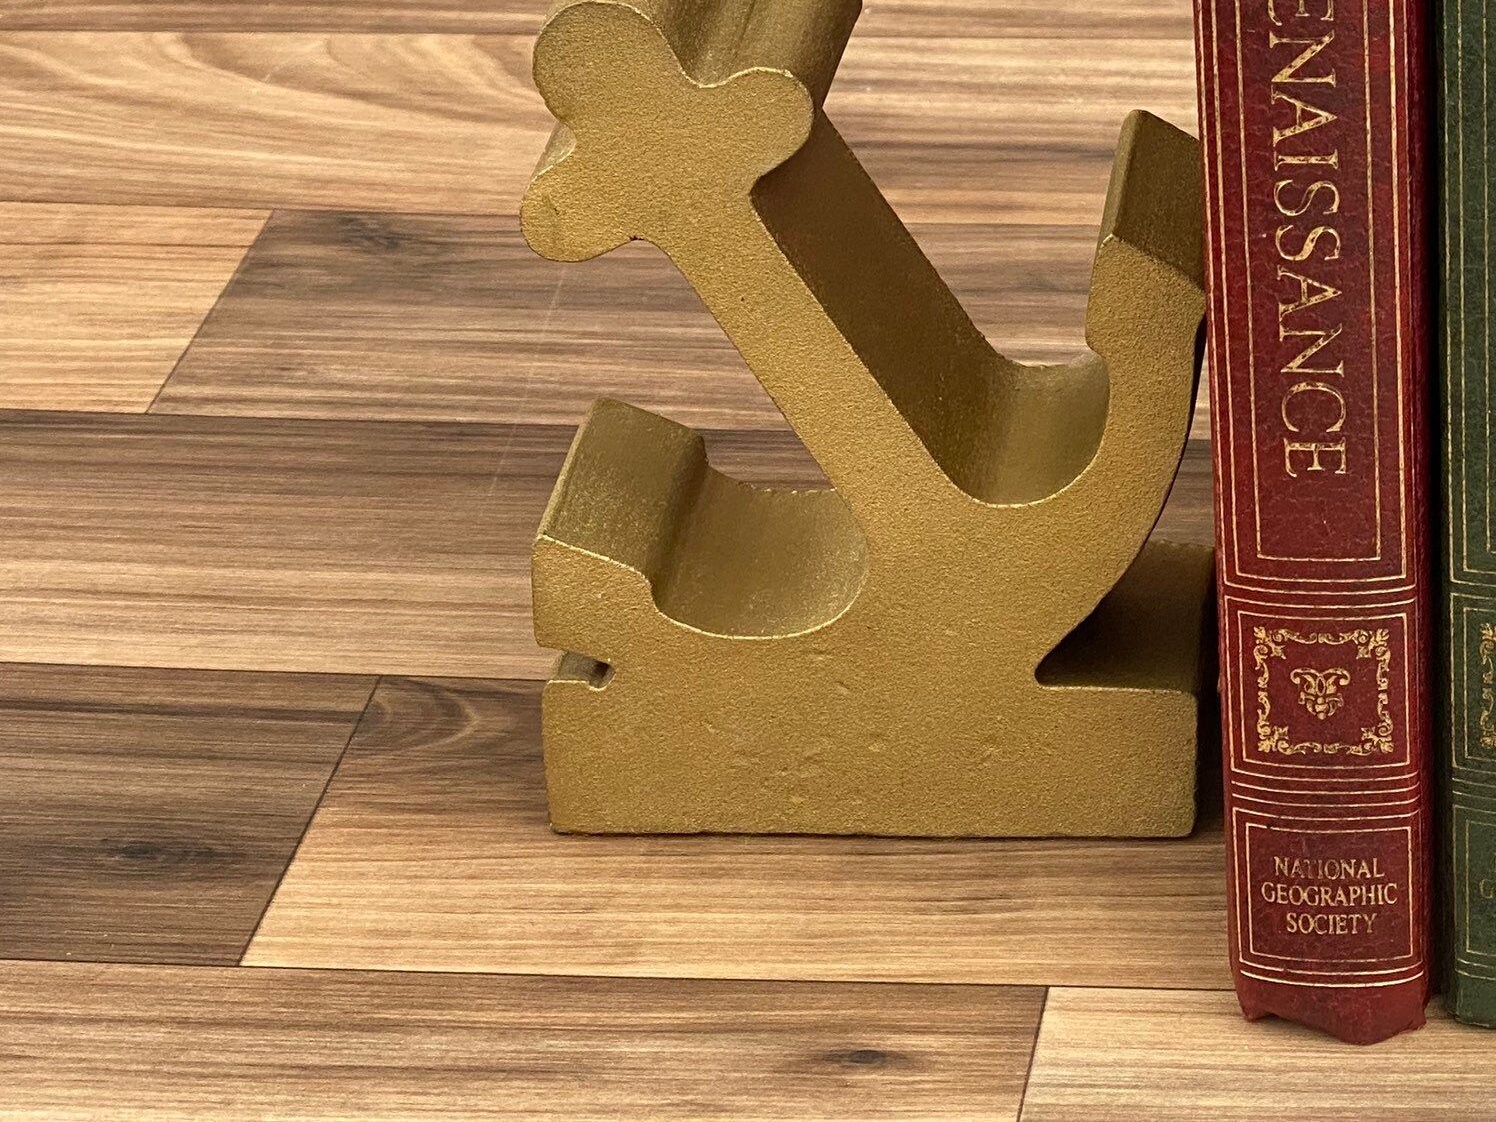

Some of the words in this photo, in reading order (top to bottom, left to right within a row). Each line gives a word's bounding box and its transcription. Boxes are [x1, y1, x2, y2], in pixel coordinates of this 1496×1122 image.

[1273, 855, 1386, 880] NATIONAL
[1260, 881, 1399, 907] GEOGRAPHIC
[1285, 912, 1378, 936] SOCIETY
